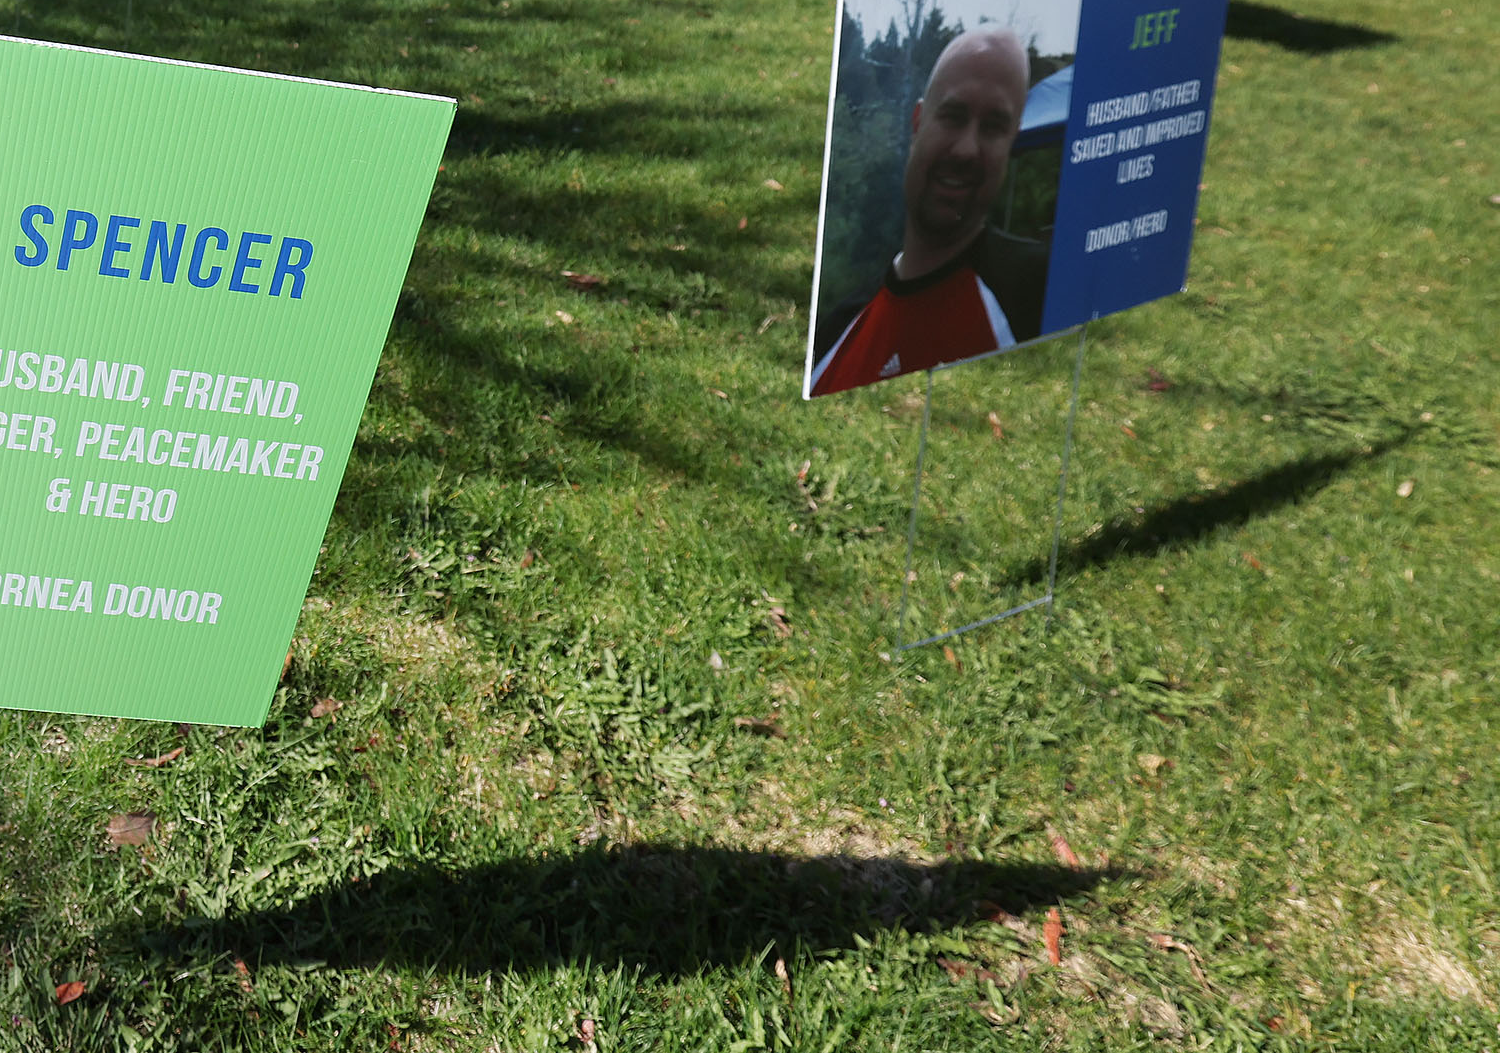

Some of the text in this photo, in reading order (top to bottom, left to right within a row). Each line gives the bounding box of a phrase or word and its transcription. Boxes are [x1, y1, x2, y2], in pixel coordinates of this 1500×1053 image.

[1129, 8, 1180, 50] JEFF
[1086, 79, 1200, 127] HUSBAND/FATHER
[1070, 110, 1206, 164] SAVED AND IMPROVED
[1117, 154, 1155, 184] LIVES
[14, 204, 314, 299] SPENCER
[1085, 209, 1168, 253] DONOR/HERO
[163, 369, 304, 425] FRIEND,
[75, 421, 324, 481] PEACEMAKER
[46, 478, 178, 523] & HERO
[103, 583, 223, 624] DONOR
